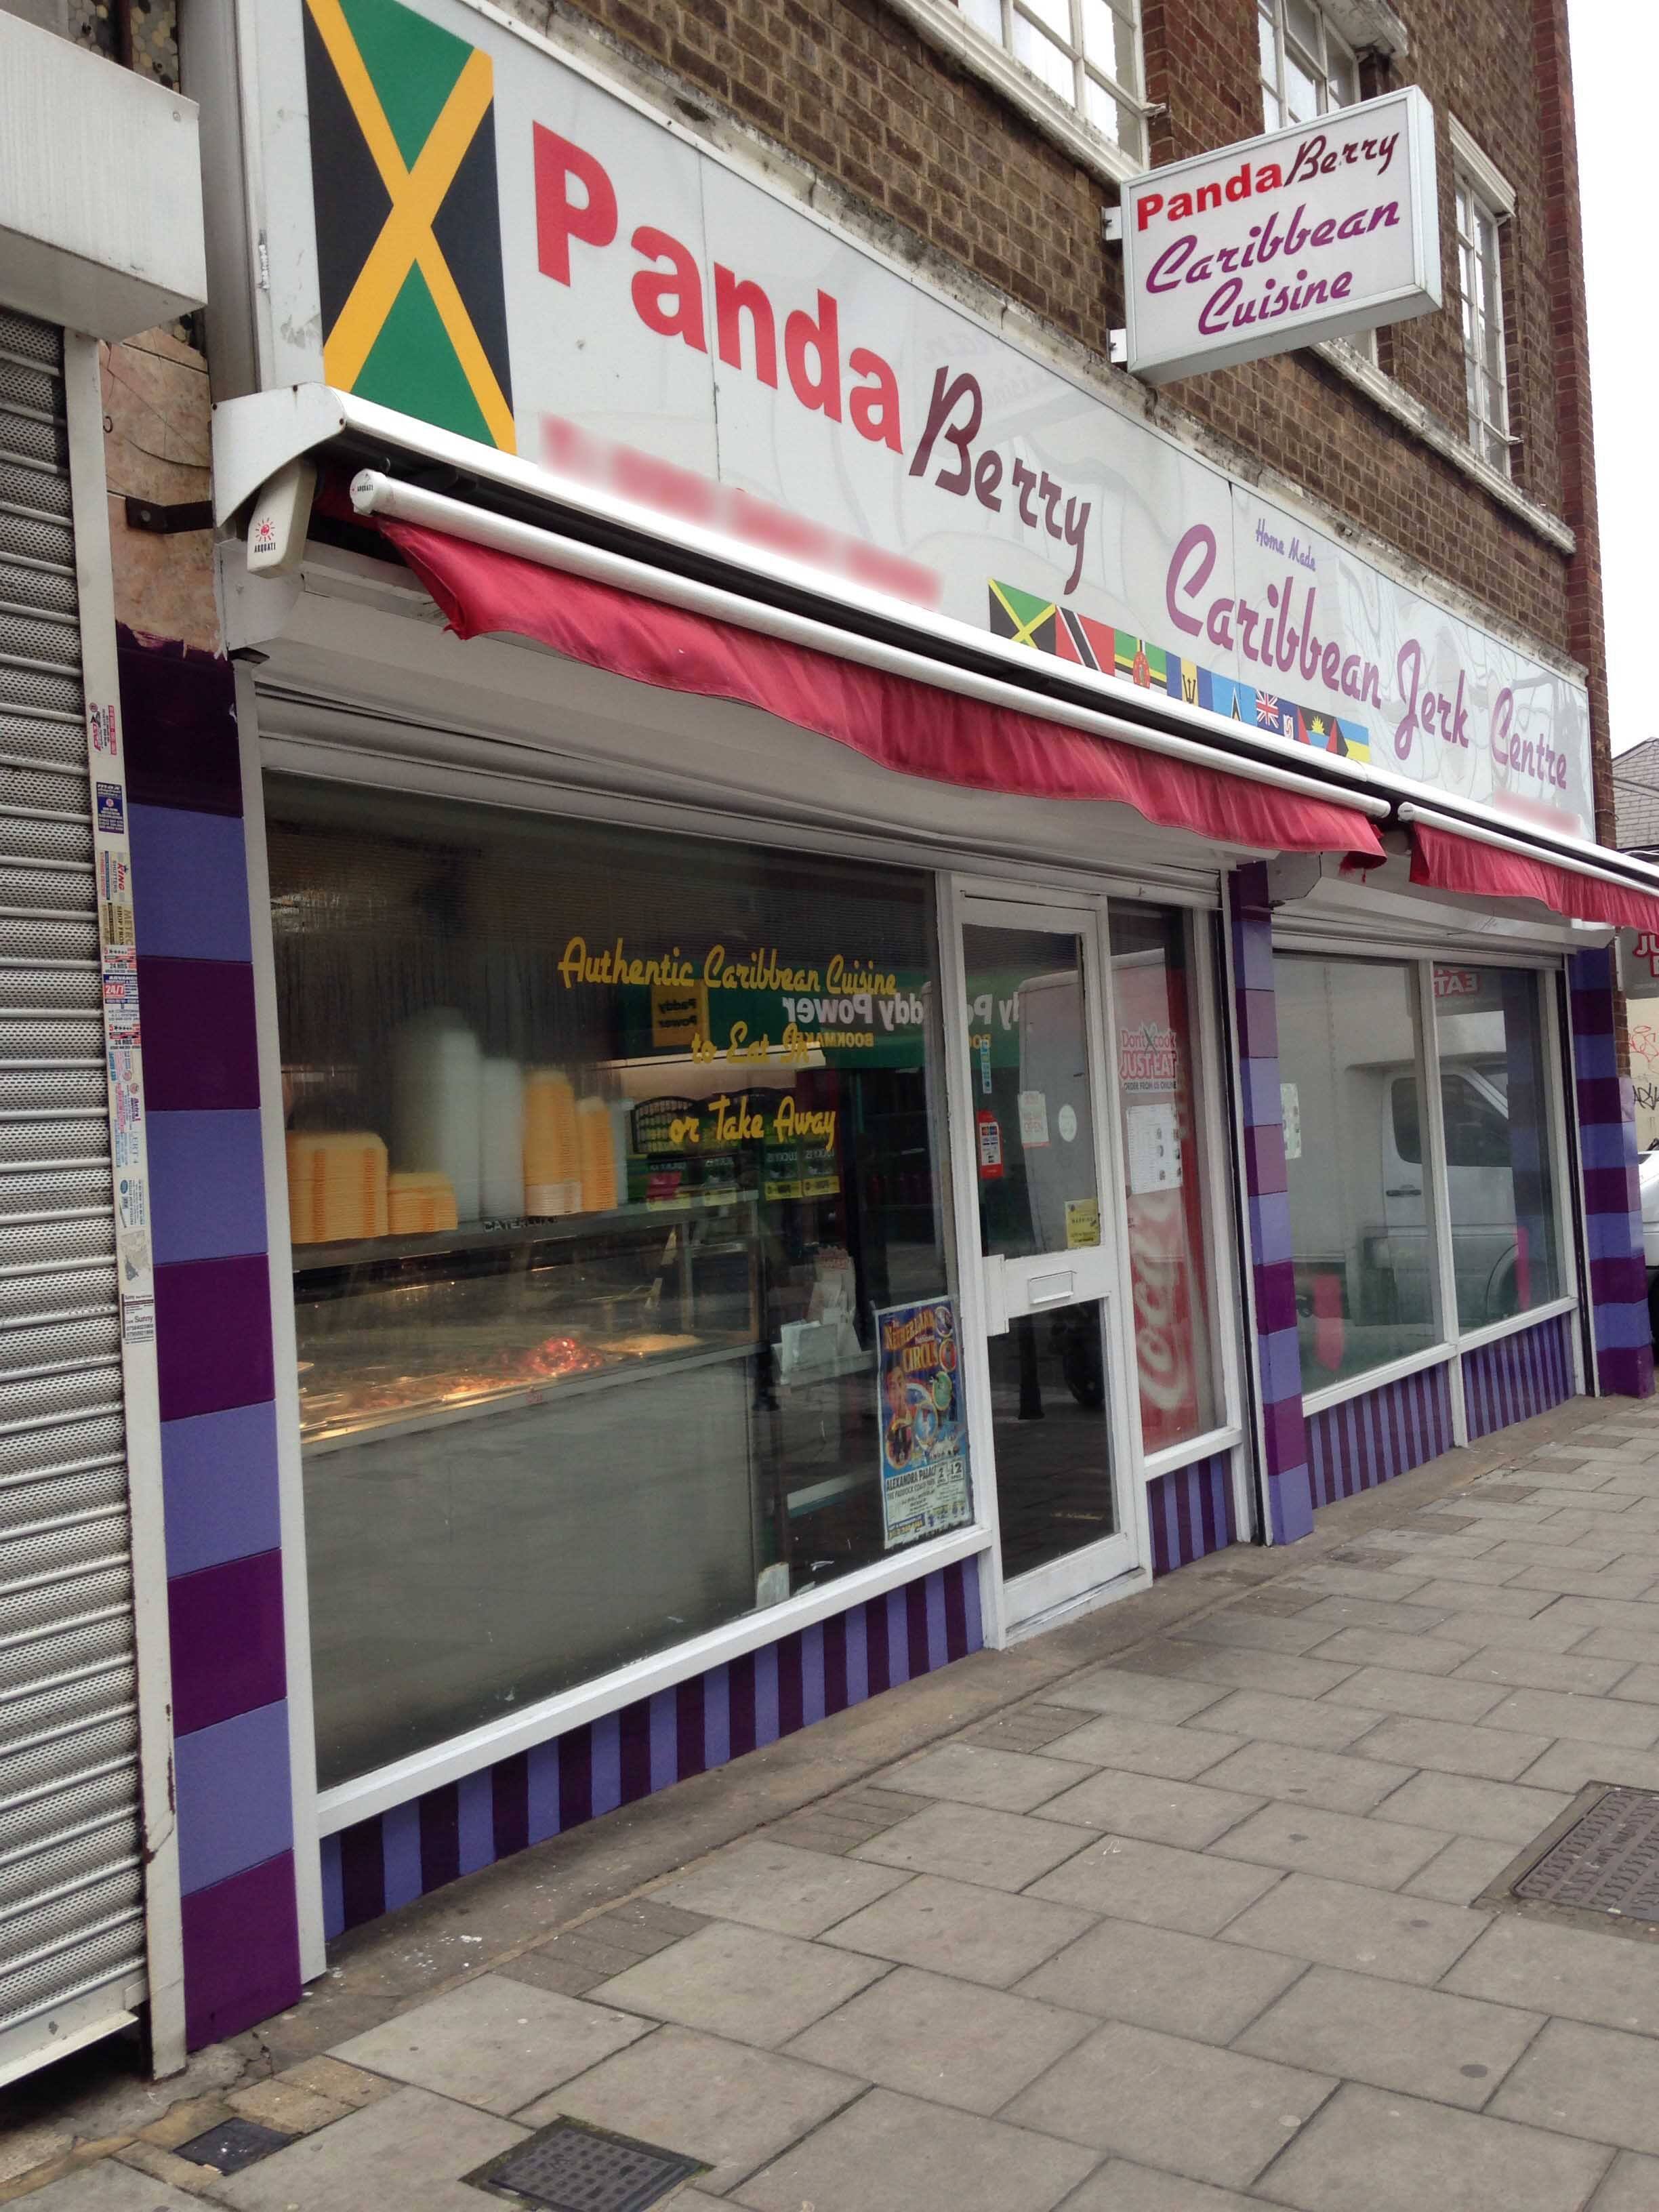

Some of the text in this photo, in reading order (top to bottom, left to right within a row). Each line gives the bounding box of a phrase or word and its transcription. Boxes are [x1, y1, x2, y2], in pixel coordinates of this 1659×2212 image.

[1146, 201, 1400, 293] Caribbean
[1198, 269, 1353, 335] Cuisine
[1256, 518, 1316, 572] Home Made
[1166, 524, 1568, 790] Caribbean Jerk Centre
[558, 937, 897, 995] Authentic Caribbean Cuisine
[691, 1021, 810, 1063] to Eat In
[669, 1094, 836, 1151] or Take Away
[902, 1341, 940, 1373] CIRCUS
[951, 1462, 962, 1475] 12
